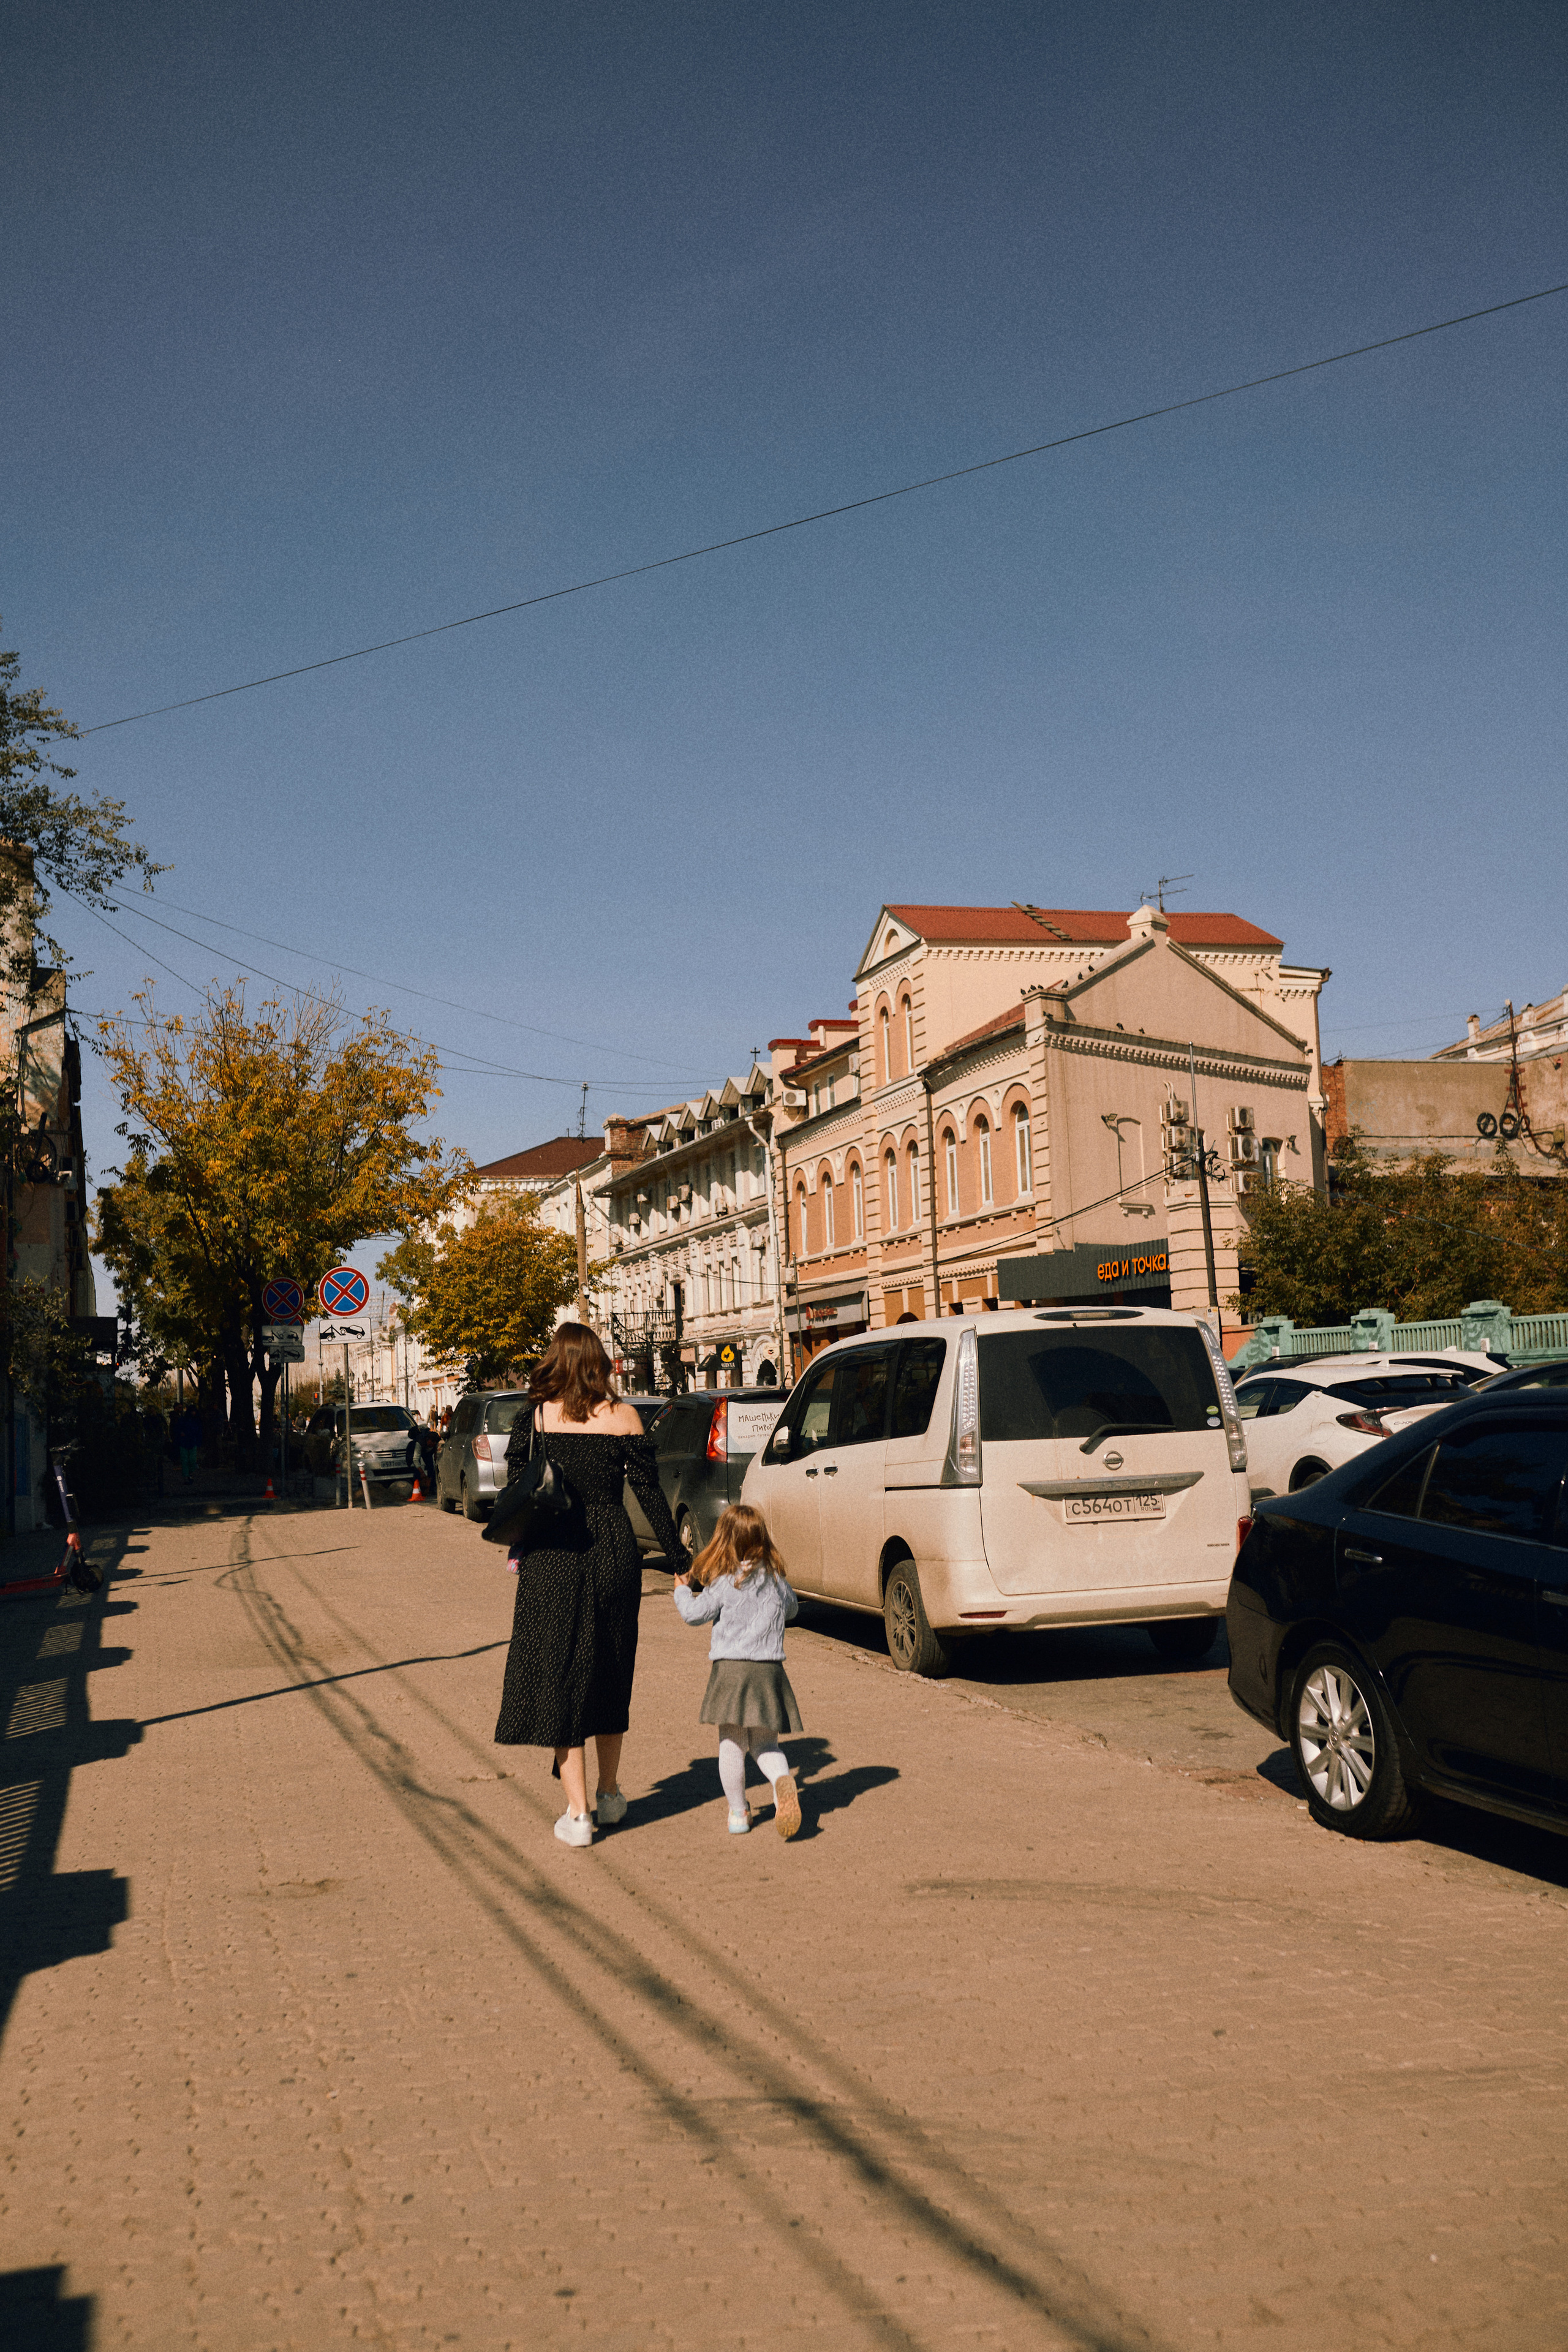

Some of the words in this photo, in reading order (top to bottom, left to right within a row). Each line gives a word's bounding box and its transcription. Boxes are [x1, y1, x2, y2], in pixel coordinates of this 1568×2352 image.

[1098, 1262, 1119, 1282] еда
[1122, 1259, 1129, 1276] и
[1136, 1493, 1158, 1506] 125
